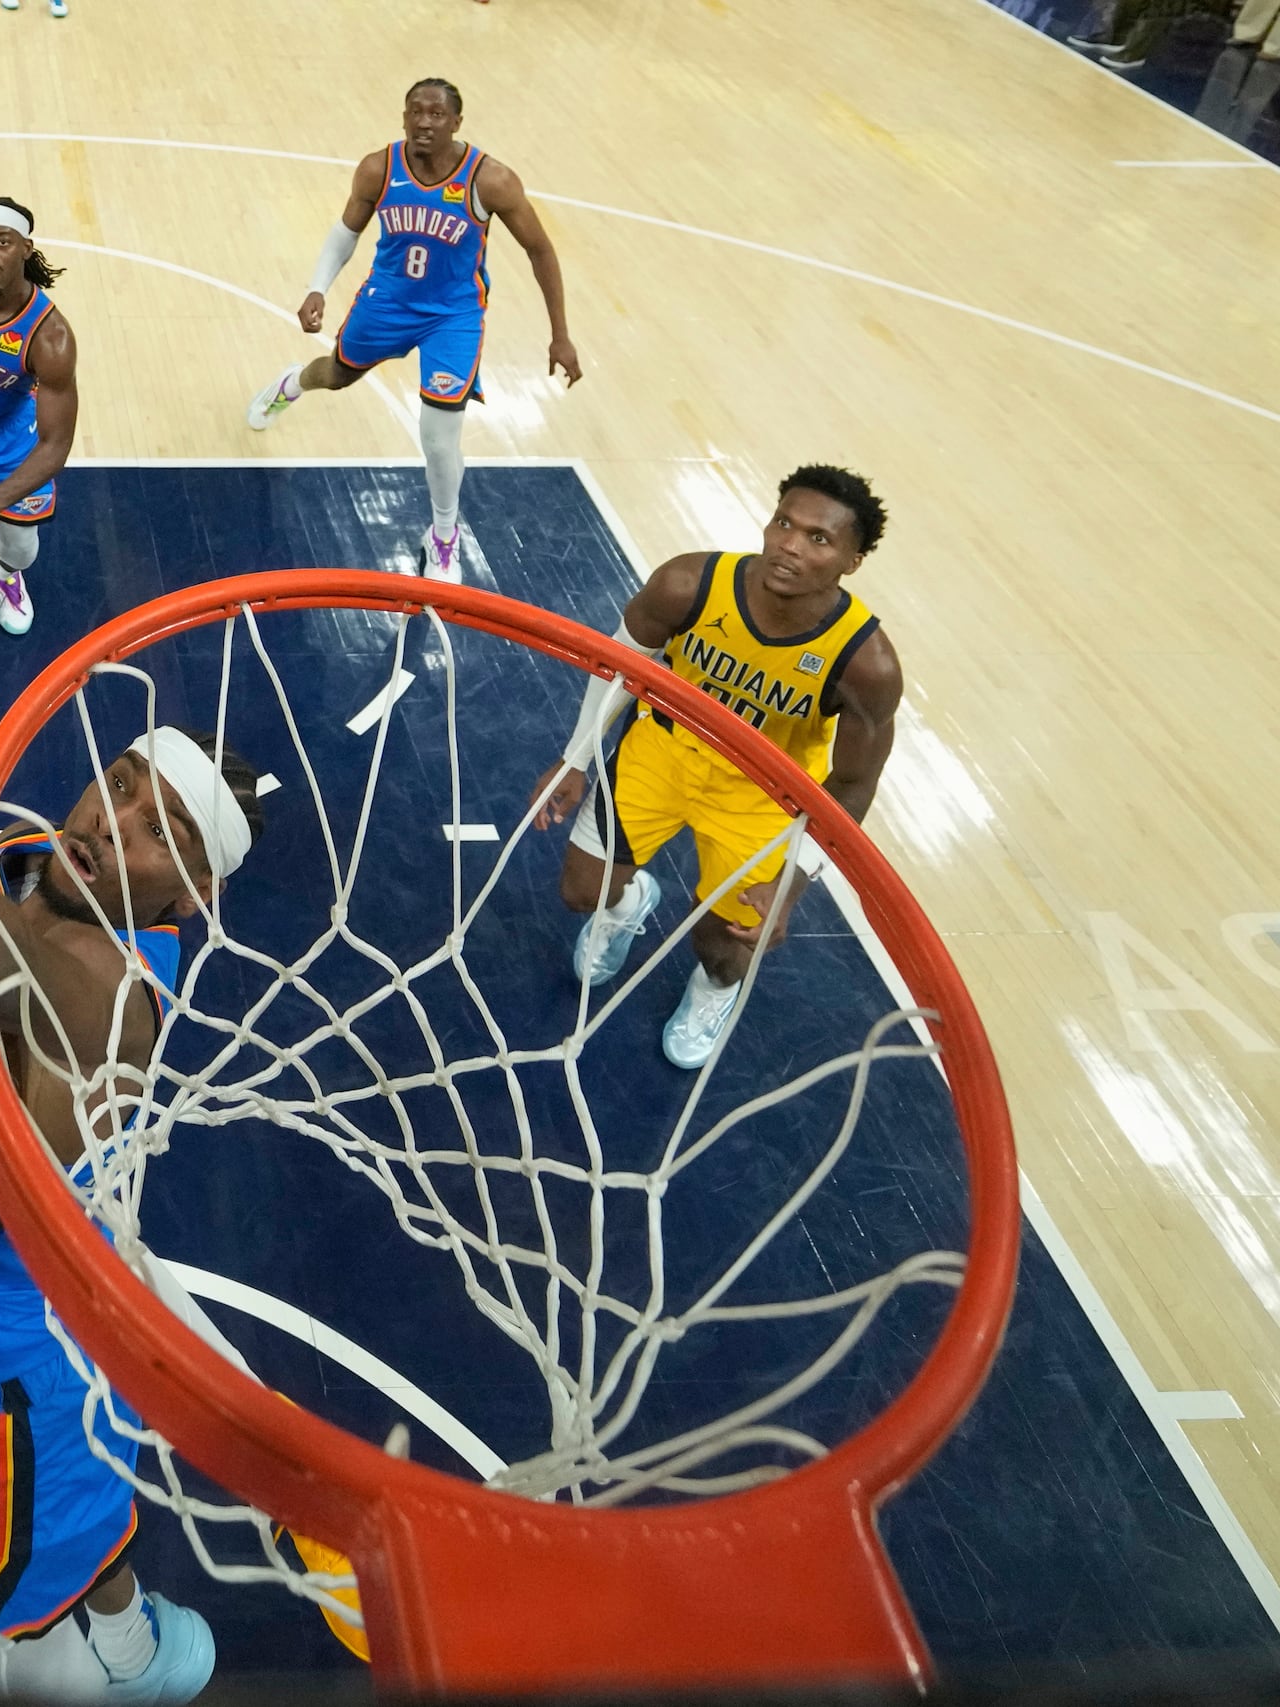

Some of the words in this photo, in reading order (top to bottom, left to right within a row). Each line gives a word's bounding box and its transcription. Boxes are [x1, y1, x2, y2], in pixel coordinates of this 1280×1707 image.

[381, 205, 470, 246] THUNDER
[406, 244, 429, 280] 8
[681, 632, 814, 721] INDIANA
